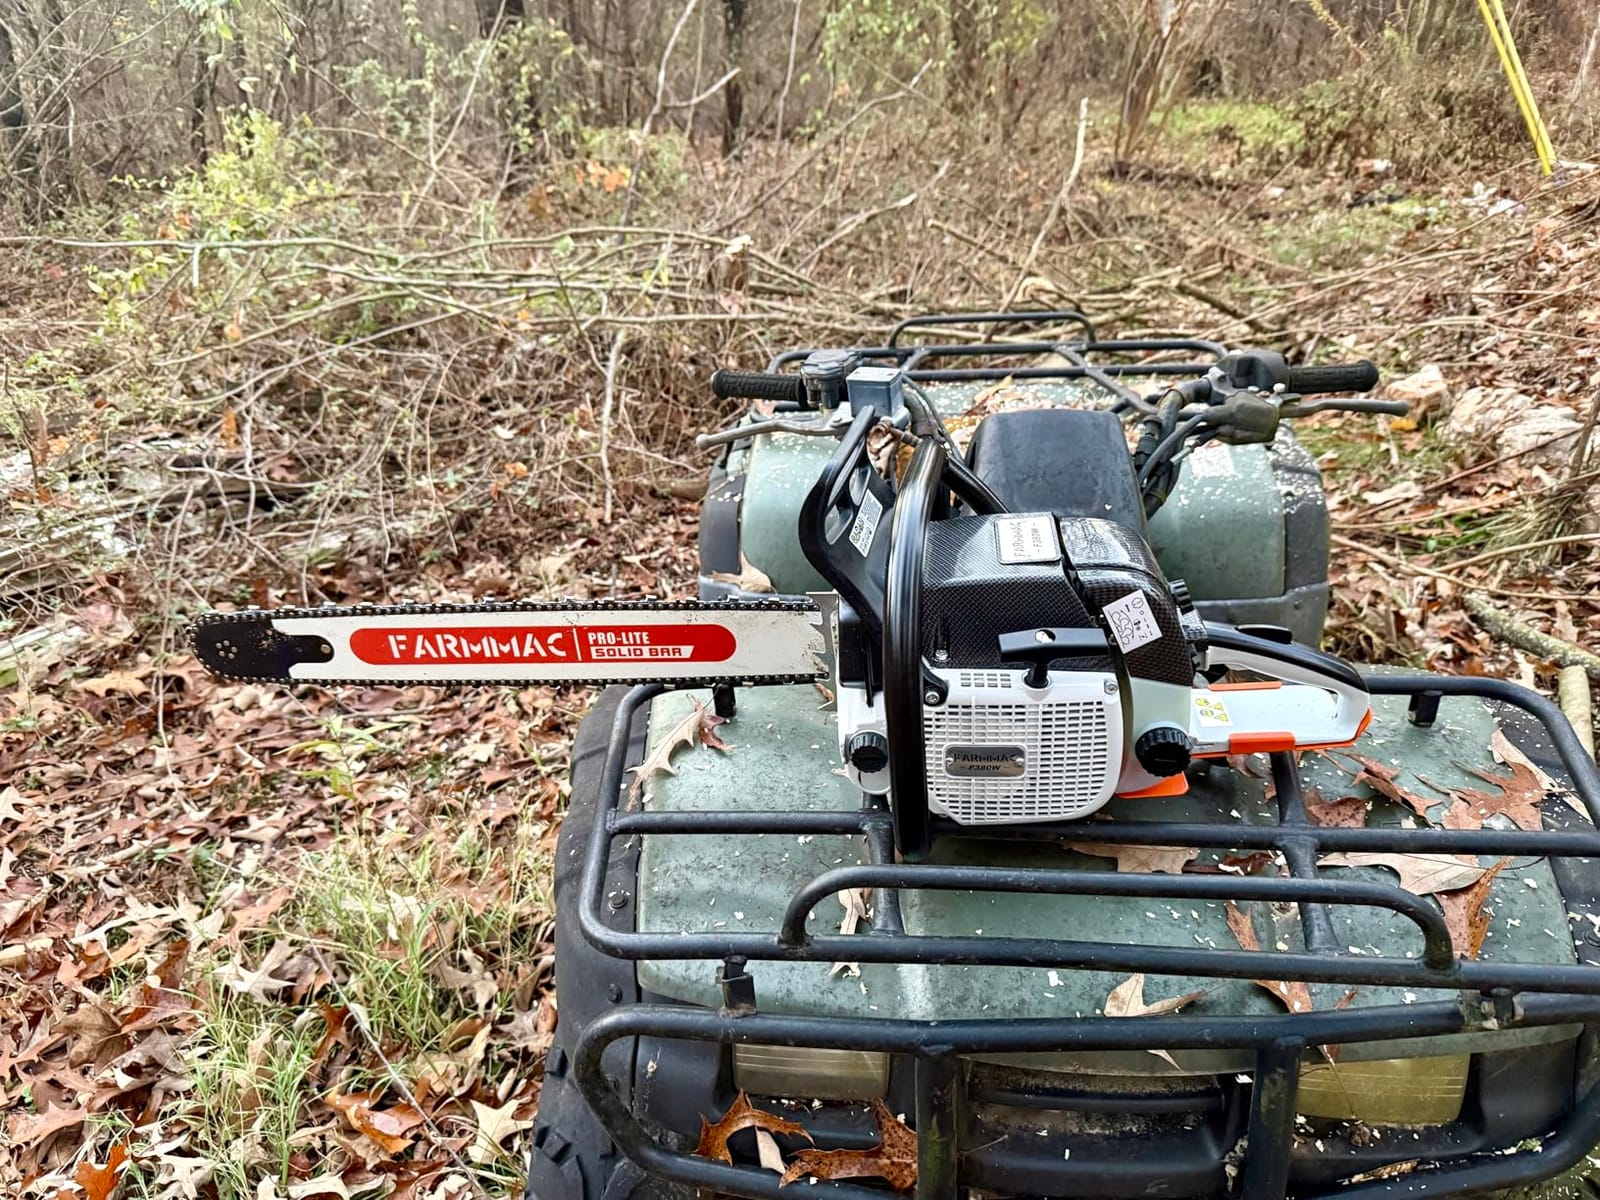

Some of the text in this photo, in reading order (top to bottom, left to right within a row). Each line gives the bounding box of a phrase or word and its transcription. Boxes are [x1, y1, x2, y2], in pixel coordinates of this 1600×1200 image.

[587, 631, 651, 645] PRO-LITE
[388, 632, 567, 659] FARMMAC
[595, 646, 683, 657] SOLID BAR
[953, 753, 1018, 763] FARMMAC
